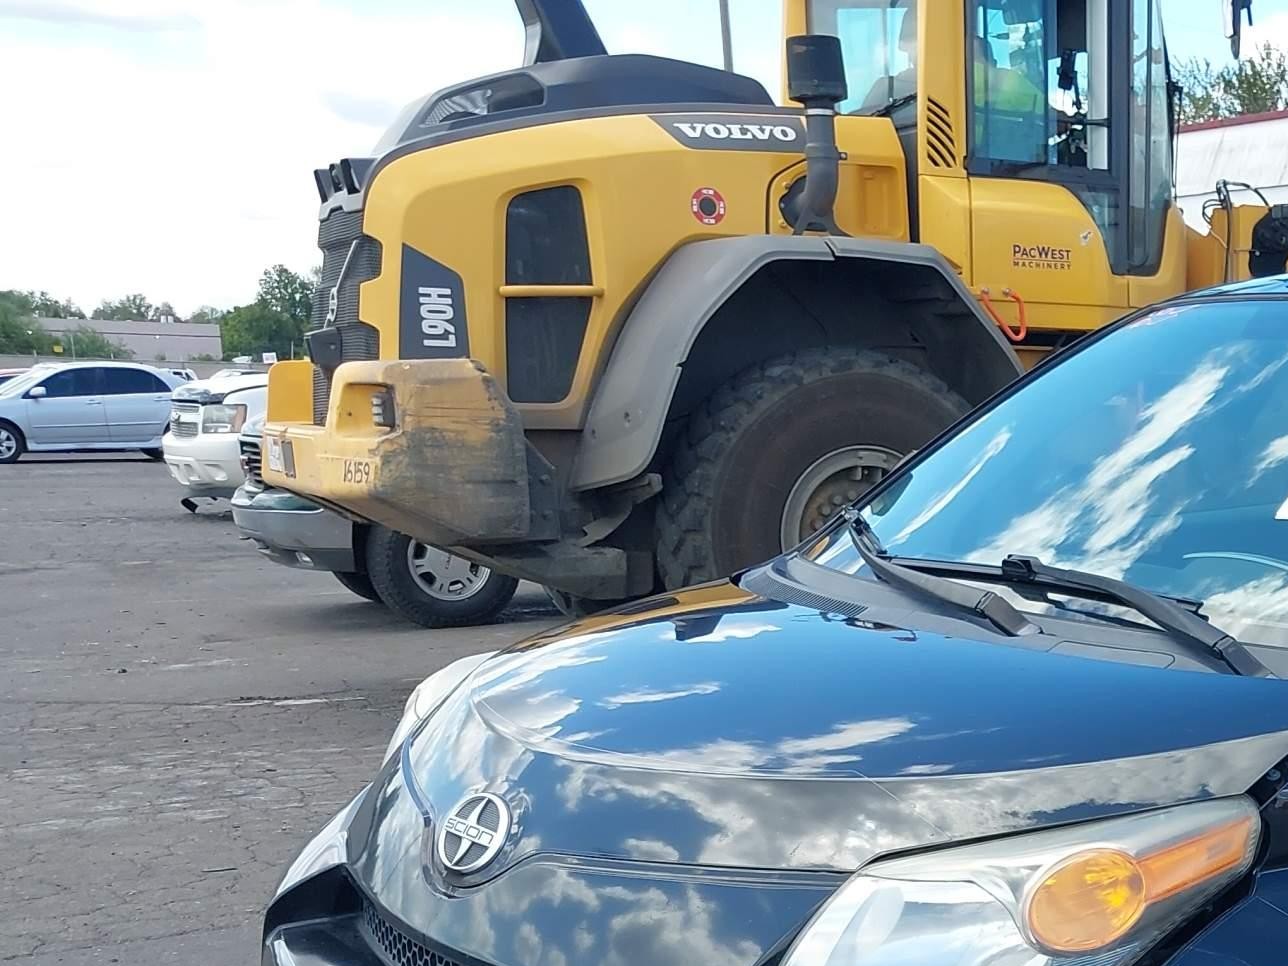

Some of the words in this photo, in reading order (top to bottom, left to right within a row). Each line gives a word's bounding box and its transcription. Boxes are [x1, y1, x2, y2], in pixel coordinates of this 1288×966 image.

[672, 122, 797, 142] VOLVO
[1012, 260, 1072, 270] MACHINERY
[417, 286, 457, 347] L90H
